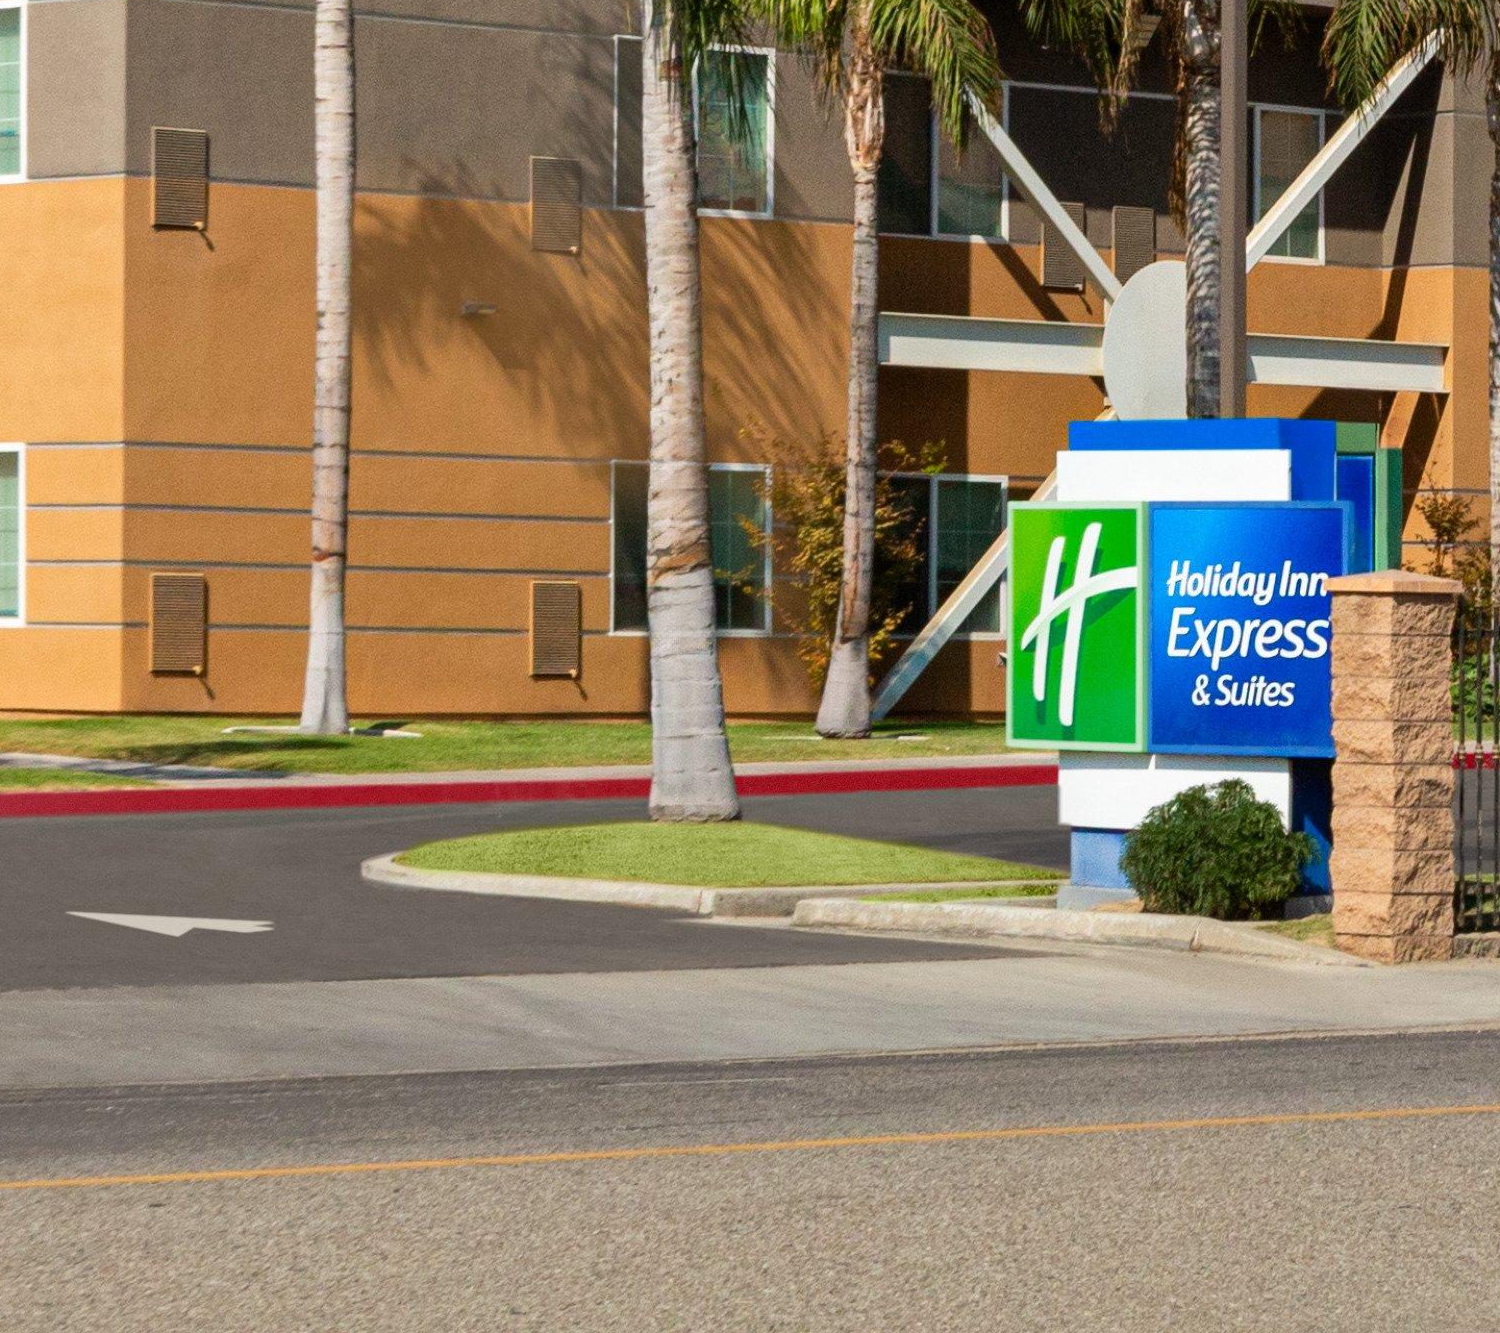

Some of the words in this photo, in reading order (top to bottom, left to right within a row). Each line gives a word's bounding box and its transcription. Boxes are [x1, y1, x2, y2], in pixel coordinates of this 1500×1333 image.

[1166, 559, 1277, 606] Holiday
[1279, 559, 1329, 597] Inn
[1167, 606, 1330, 671] Express
[1191, 673, 1211, 706] &
[1214, 673, 1296, 707] Suites
